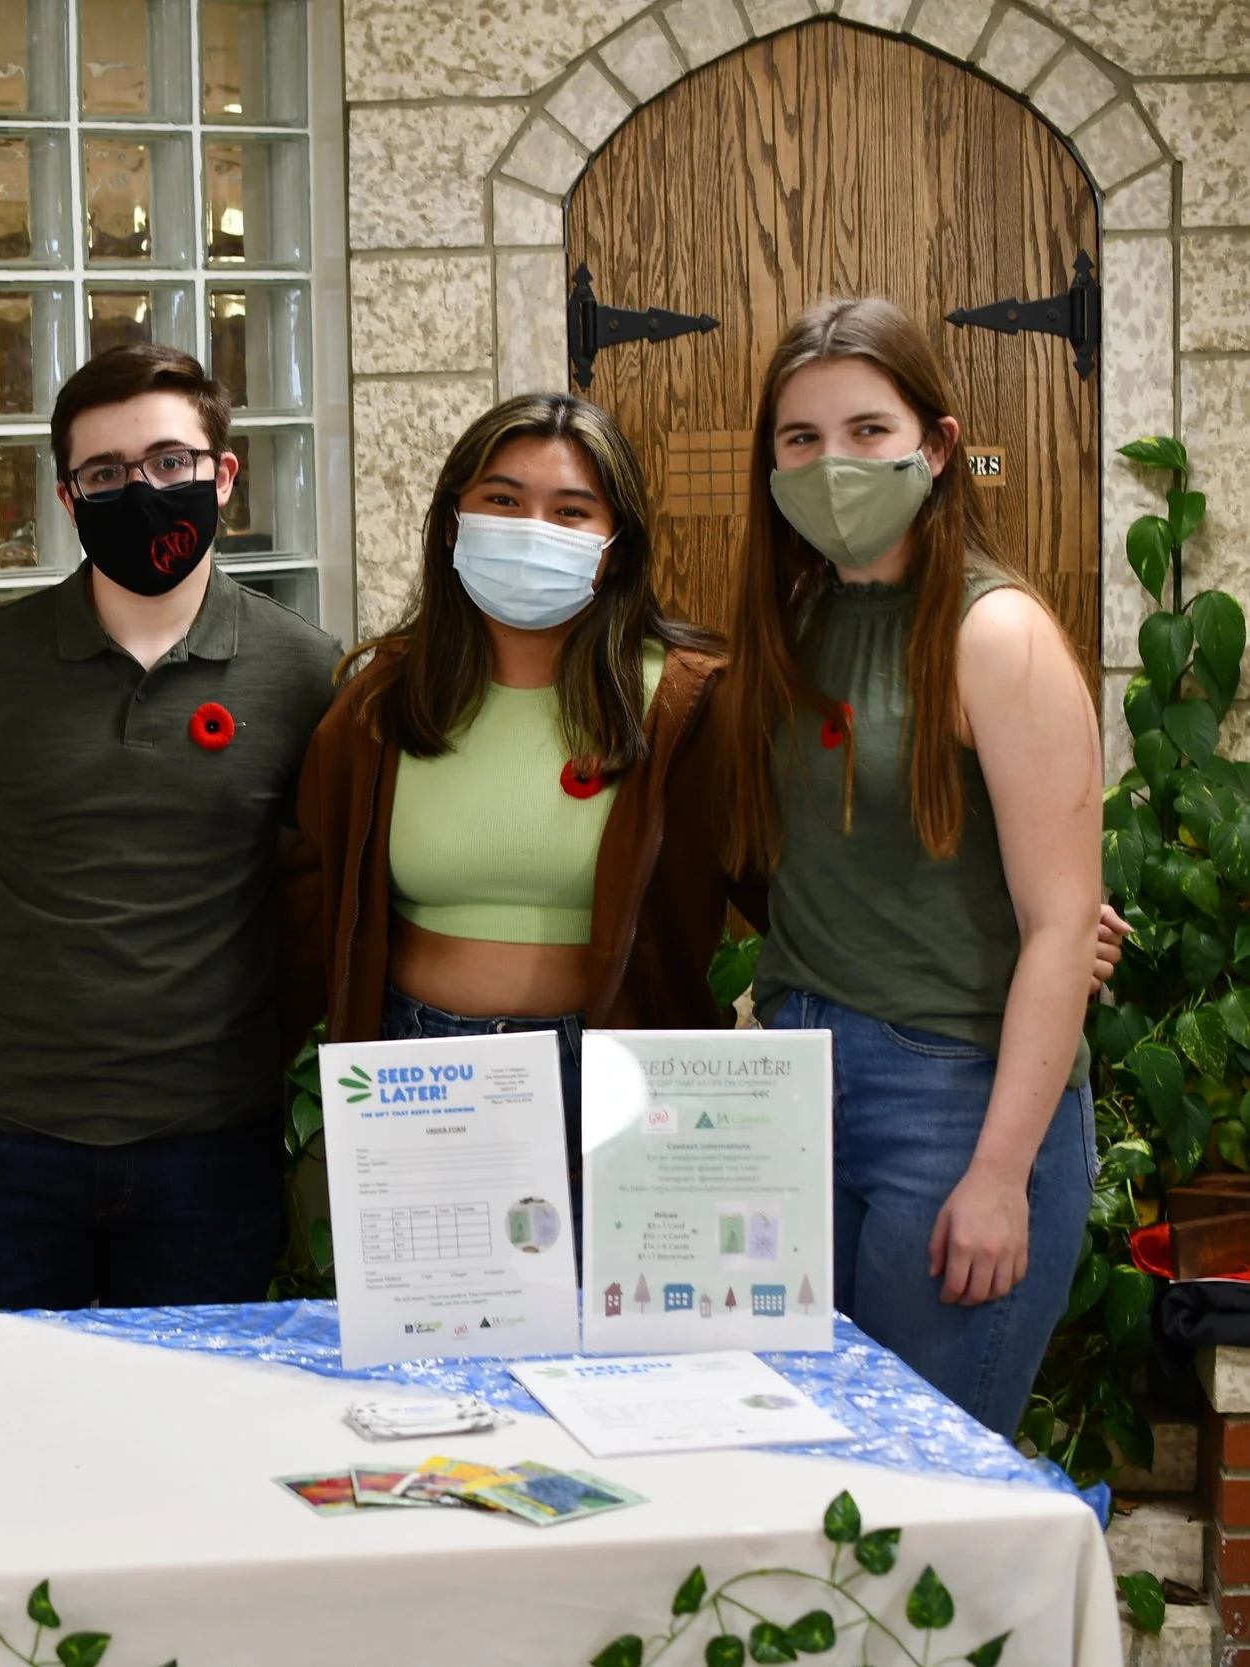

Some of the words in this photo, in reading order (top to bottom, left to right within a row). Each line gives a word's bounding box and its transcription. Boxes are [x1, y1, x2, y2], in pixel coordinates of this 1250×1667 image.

[377, 1066, 424, 1085] SEED
[429, 1064, 474, 1083] YOU
[639, 1060, 674, 1076] EED
[680, 1060, 721, 1076] YOU
[727, 1060, 791, 1076] LATER!
[379, 1085, 447, 1104] LATER!
